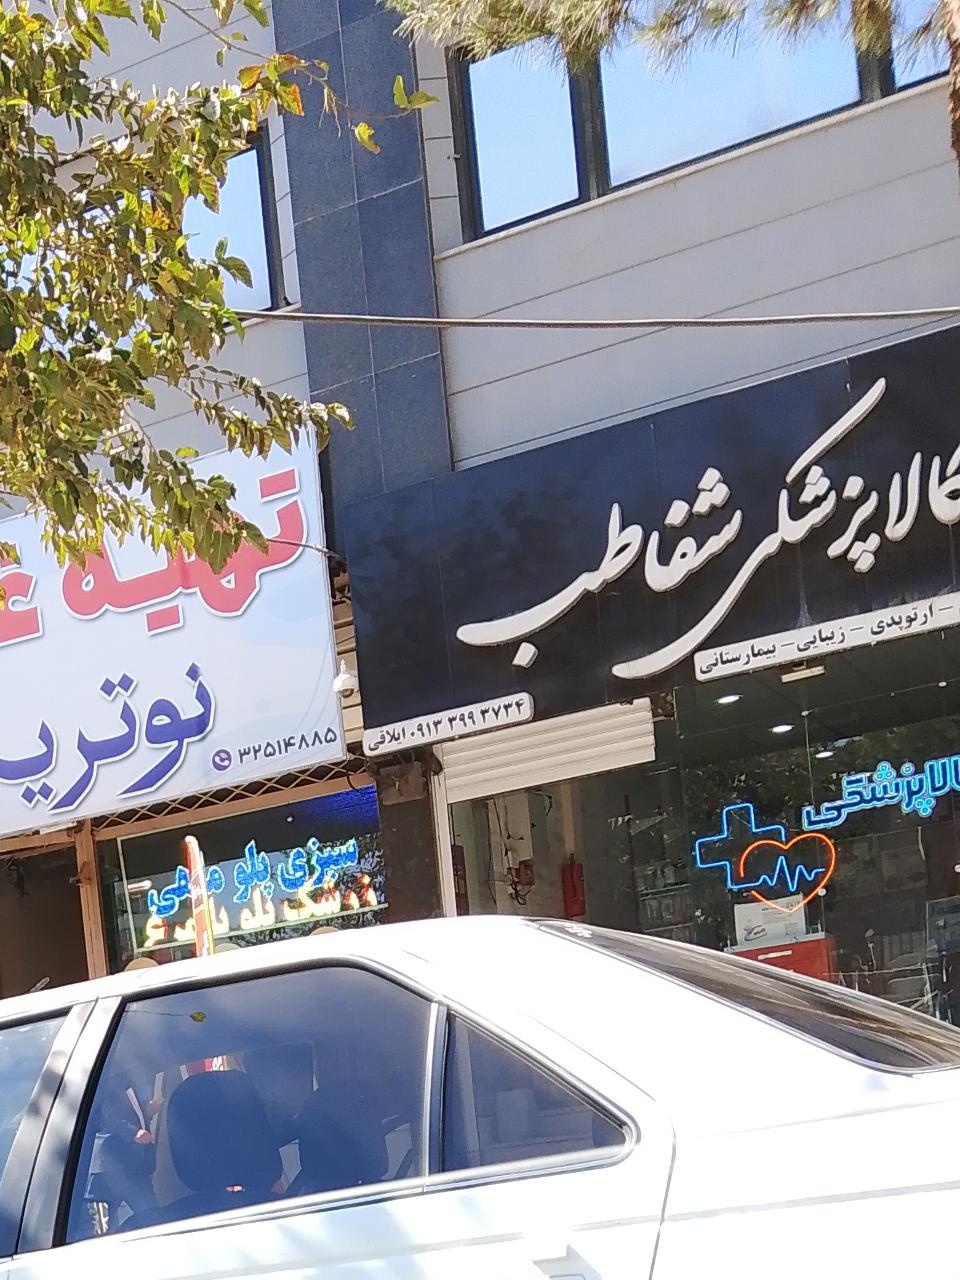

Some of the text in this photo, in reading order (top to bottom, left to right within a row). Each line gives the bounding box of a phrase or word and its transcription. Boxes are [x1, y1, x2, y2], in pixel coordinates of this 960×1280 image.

[611, 377, 886, 680] پزشکی
[699, 603, 935, 675] ارتوپدی زیبایی بیمارستانی
[237, 726, 338, 764] ۳۲۵۱۴۸۸۵
[367, 727, 407, 752] ایلاقی
[232, 838, 275, 903] پلو
[277, 836, 359, 892] سبزی
